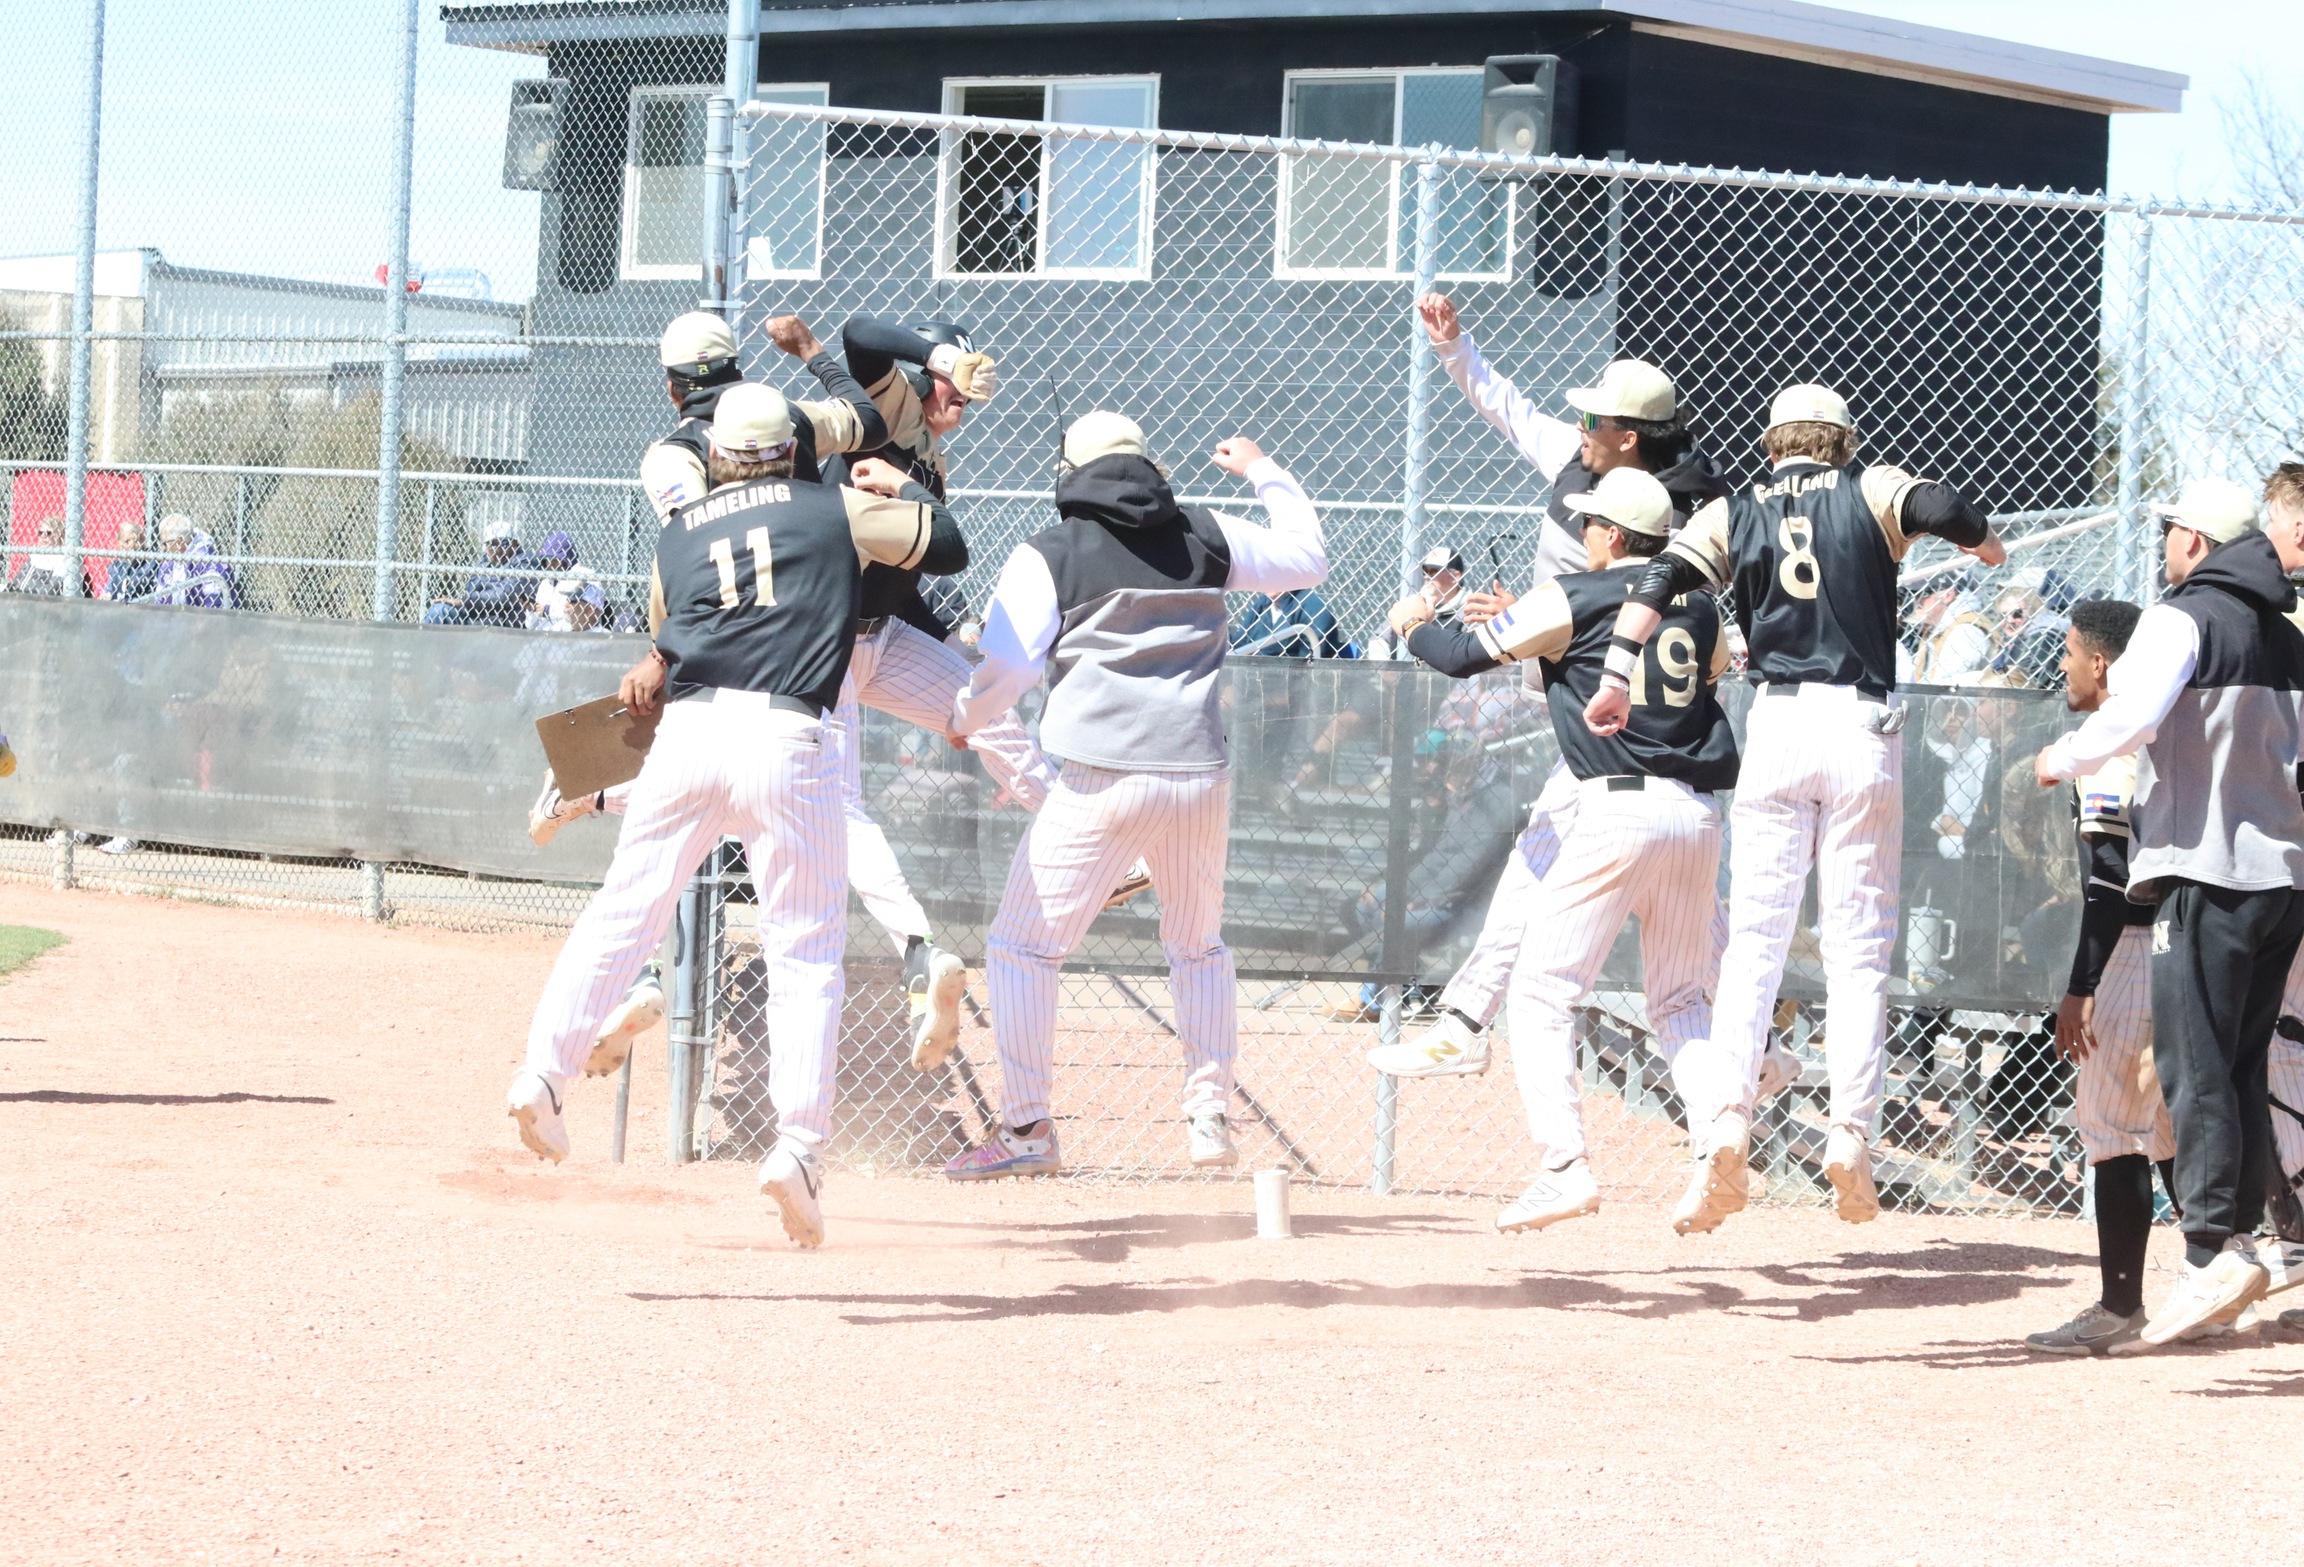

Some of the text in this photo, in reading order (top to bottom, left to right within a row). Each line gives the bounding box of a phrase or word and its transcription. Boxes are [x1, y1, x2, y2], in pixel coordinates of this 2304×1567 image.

[682, 483, 792, 531] TAMELING
[709, 526, 777, 610] 11
[1779, 516, 1821, 600] 8
